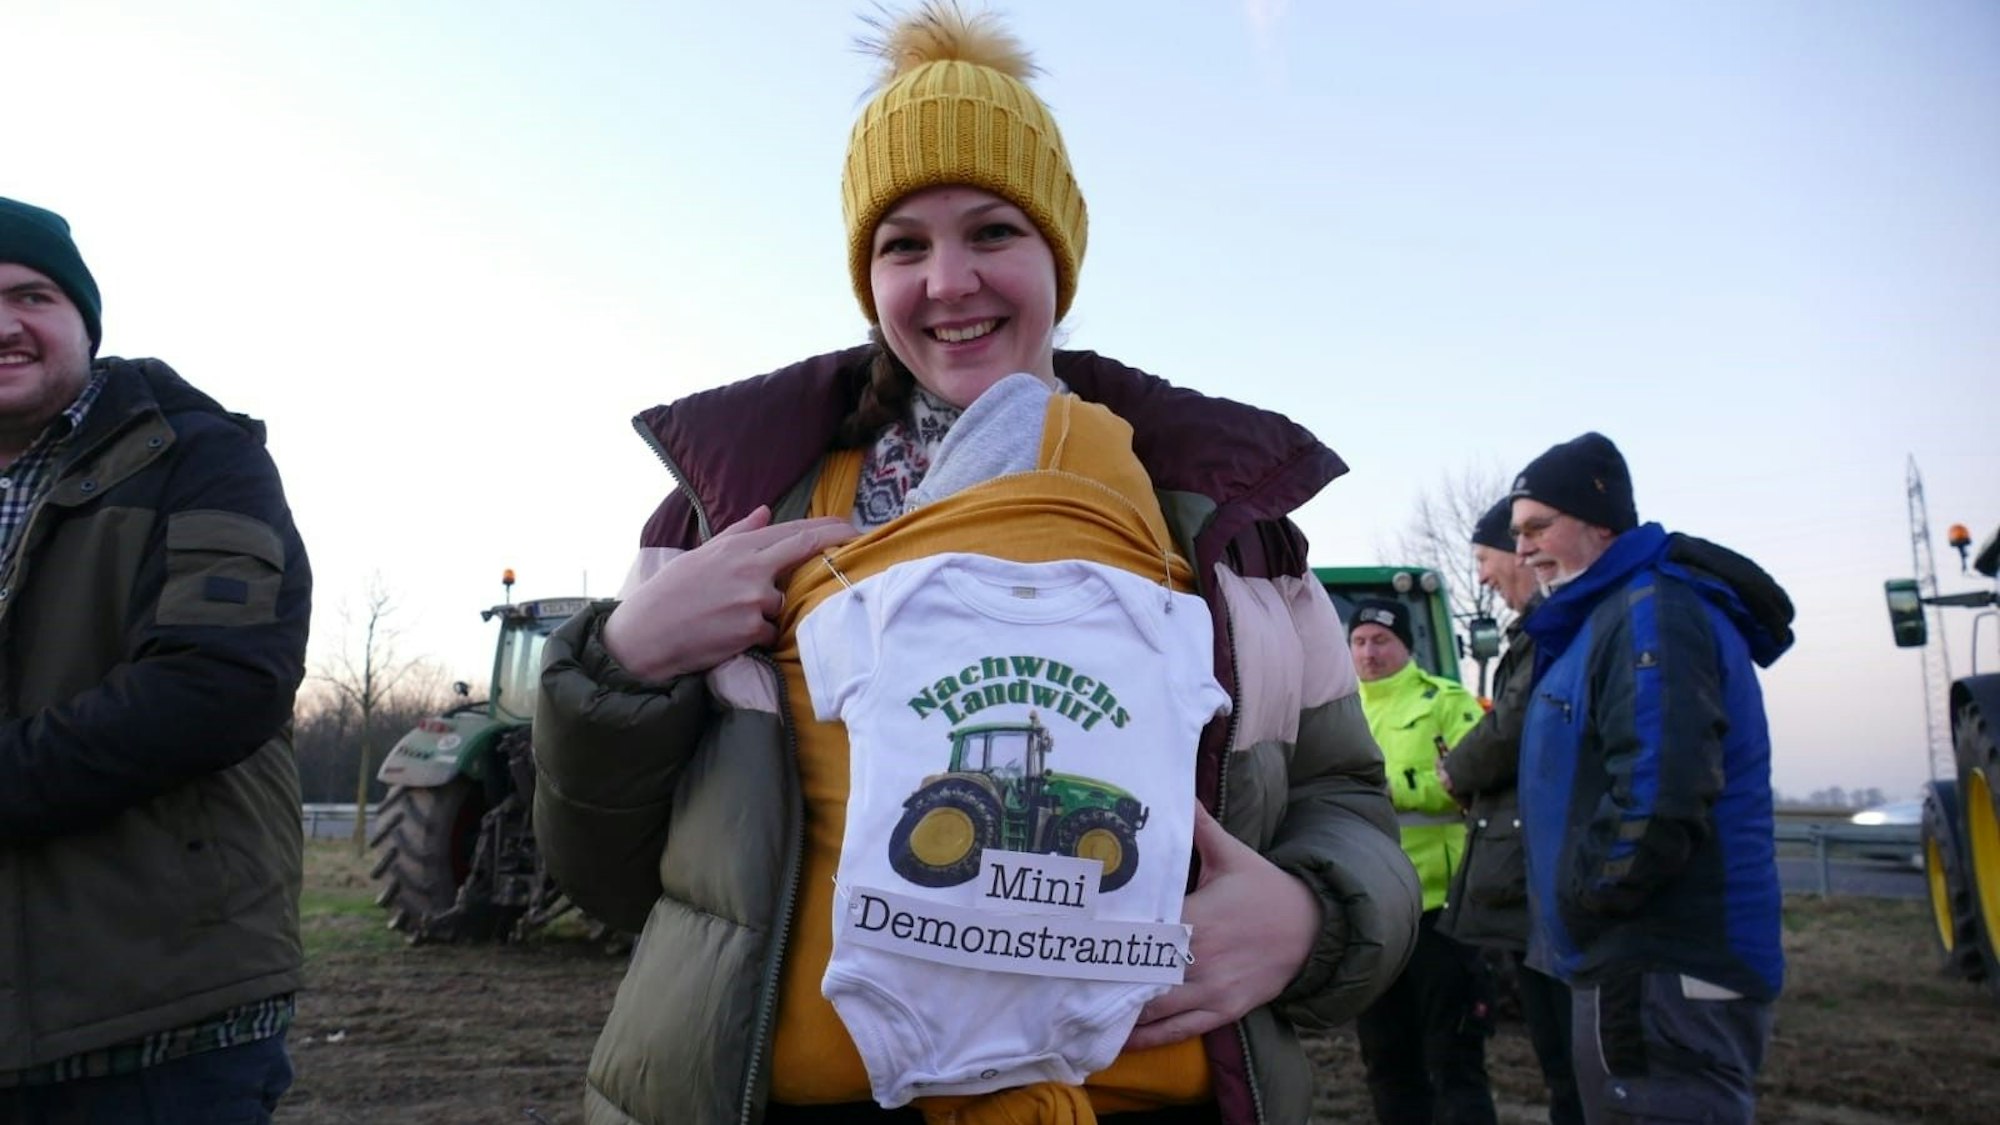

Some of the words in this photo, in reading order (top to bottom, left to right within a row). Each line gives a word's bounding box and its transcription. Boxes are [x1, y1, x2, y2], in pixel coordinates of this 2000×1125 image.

[907, 655, 1132, 730] Nachwuchs
[940, 678, 1104, 732] Landwirt
[985, 863, 1086, 908] Mini
[854, 894, 1179, 969] Demonstrantin
